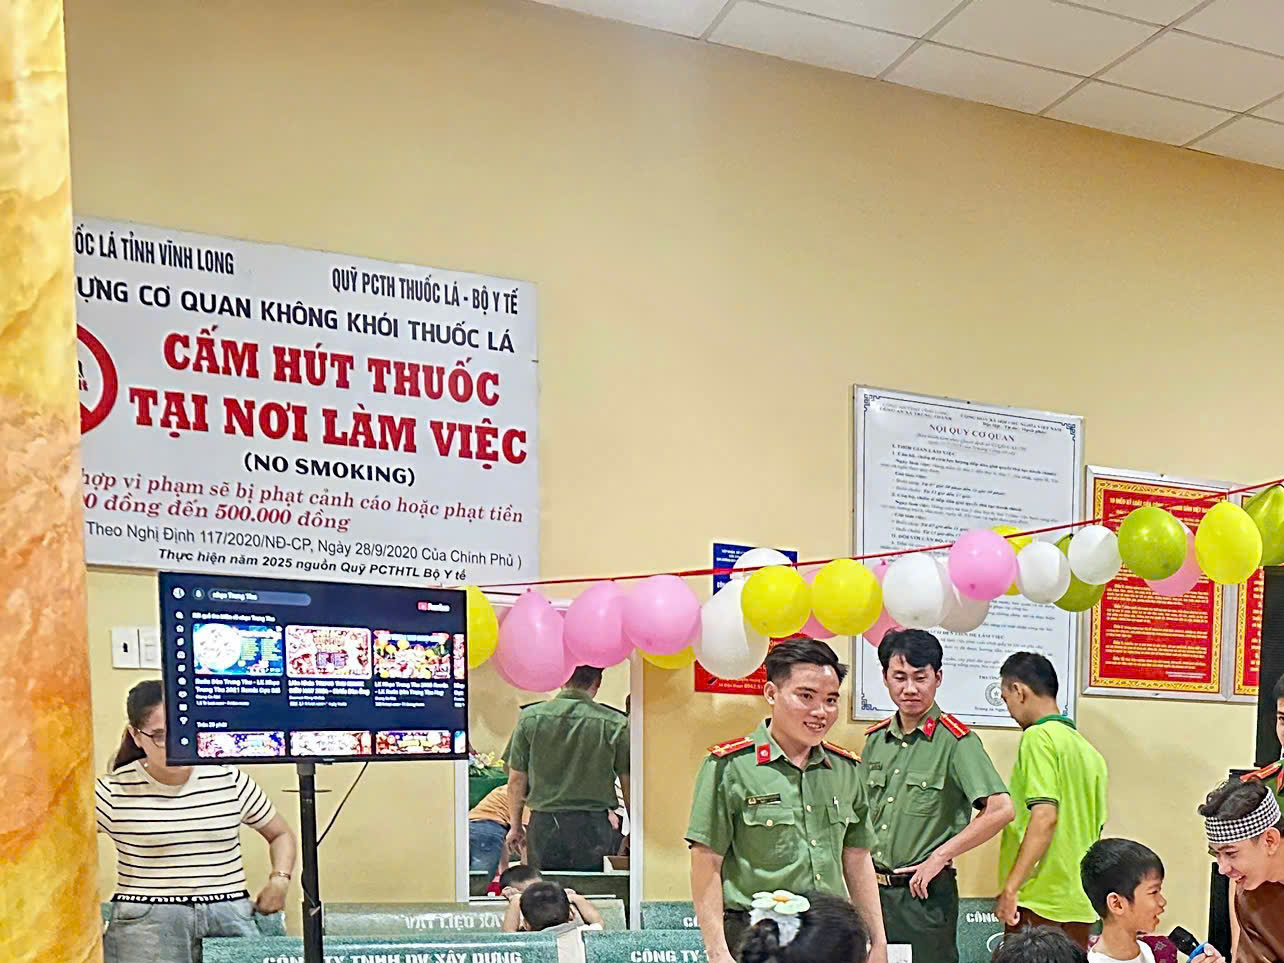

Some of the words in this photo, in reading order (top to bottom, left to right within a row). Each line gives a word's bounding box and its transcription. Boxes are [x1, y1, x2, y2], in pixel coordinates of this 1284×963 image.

[99, 231, 118, 259] LÁ
[121, 231, 155, 264] TỈNH
[159, 240, 193, 269] VĨNH
[197, 248, 234, 275] LONG
[332, 266, 357, 292] QUỸ
[362, 272, 395, 297] PCTH
[399, 274, 440, 304] THUỐC
[444, 281, 460, 307] LÁ
[472, 286, 489, 315] BỘ
[492, 292, 500, 313] Y
[503, 287, 519, 315] TẾ
[139, 284, 171, 308] CƠ
[181, 290, 251, 319] QUAN
[261, 300, 338, 330] KHÔNG
[347, 312, 399, 338] KHÓI
[408, 321, 479, 349] THUỐC
[488, 328, 515, 353] LÁ
[163, 325, 259, 379] CẤM
[273, 342, 354, 390] HÚT
[368, 357, 500, 406] THUỐC
[129, 387, 208, 438] TẠI
[223, 396, 308, 443] NƠI
[323, 403, 417, 453] LÀM
[430, 418, 527, 470] VIỆC
[244, 452, 289, 473] (NO
[295, 457, 416, 487] SMOKING)
[104, 492, 162, 518] đồng
[167, 500, 208, 518] đến
[215, 504, 292, 525] 500.000
[297, 509, 351, 532] đồng
[124, 474, 141, 490] vi
[148, 475, 204, 498] phạm
[209, 481, 230, 497] sẽ
[236, 482, 254, 504] bị
[260, 485, 303, 507] phạt
[309, 488, 354, 508] cảnh
[360, 495, 391, 511] cáo
[397, 497, 439, 519] hoặc
[444, 502, 485, 523] phạt
[489, 504, 524, 523] tiền
[86, 521, 122, 537] Theo
[127, 524, 160, 544] Nghị
[163, 527, 194, 544] Định
[200, 530, 314, 553] 117/2020/NĐ-CP,
[318, 539, 351, 557] Ngày
[355, 542, 418, 560] 28/9/2020
[421, 548, 447, 562] Của
[450, 550, 486, 565] Chính
[490, 553, 513, 568] Phủ
[159, 549, 193, 563] Thực
[197, 551, 226, 565] hiện
[230, 555, 258, 566] năm
[262, 556, 293, 568] 2025
[296, 558, 337, 572] nguồn
[340, 561, 365, 575] Quỹ
[369, 564, 420, 577] PCTHTL
[423, 568, 441, 580] Bộ
[444, 569, 452, 580] Y
[455, 569, 467, 580] tế
[631, 948, 676, 963] CÔNG
[680, 950, 700, 962] TY
